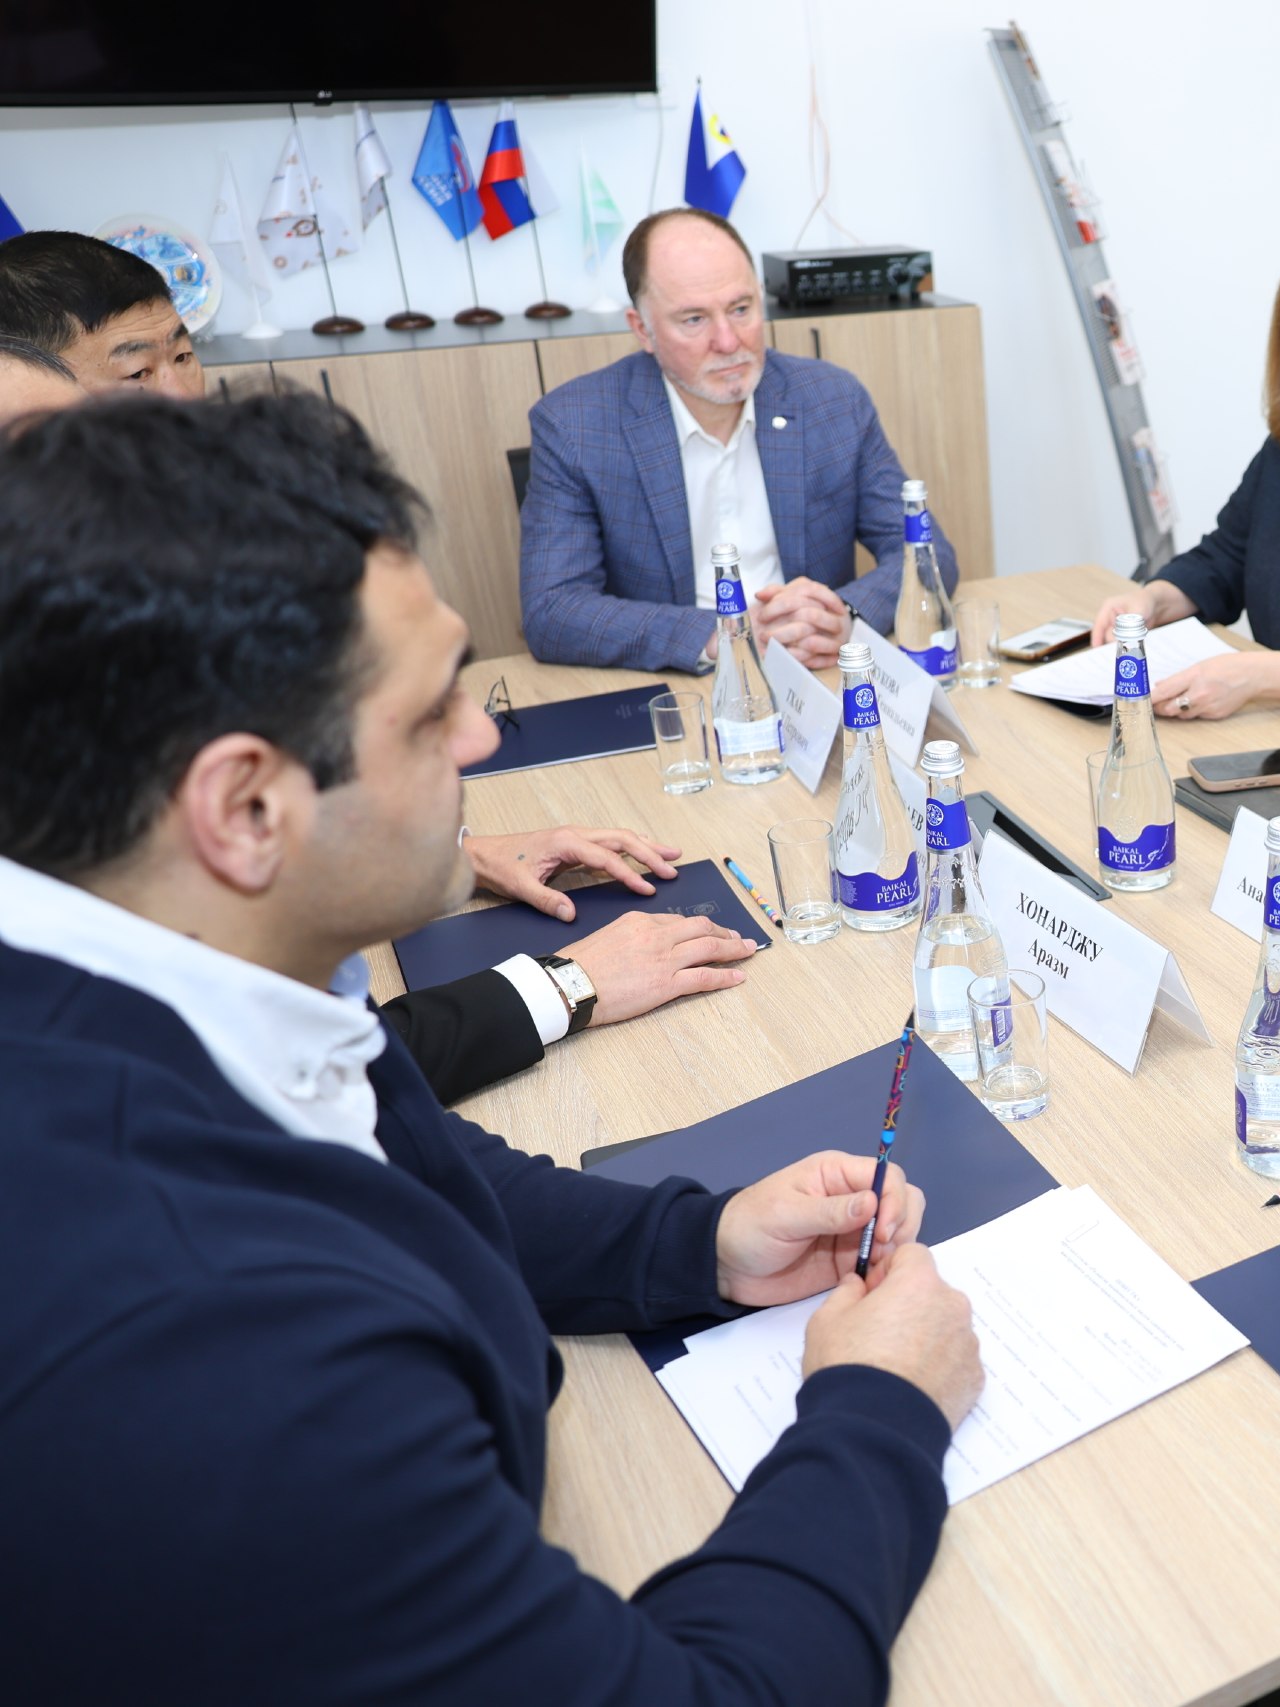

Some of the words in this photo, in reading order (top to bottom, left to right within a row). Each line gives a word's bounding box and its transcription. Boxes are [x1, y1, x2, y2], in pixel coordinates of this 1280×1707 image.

[1116, 685, 1141, 694] PEARL
[853, 713, 880, 725] PEARL
[857, 709, 876, 717] BAIKAL
[927, 834, 950, 847] EARL
[1113, 845, 1140, 855] BAIKAL
[1109, 851, 1146, 865] PEARL
[881, 880, 908, 893] BAIKAL
[876, 886, 913, 904] PEARL
[1016, 891, 1104, 962] ХОНАРДЖУ
[1028, 938, 1069, 980] Аразм
